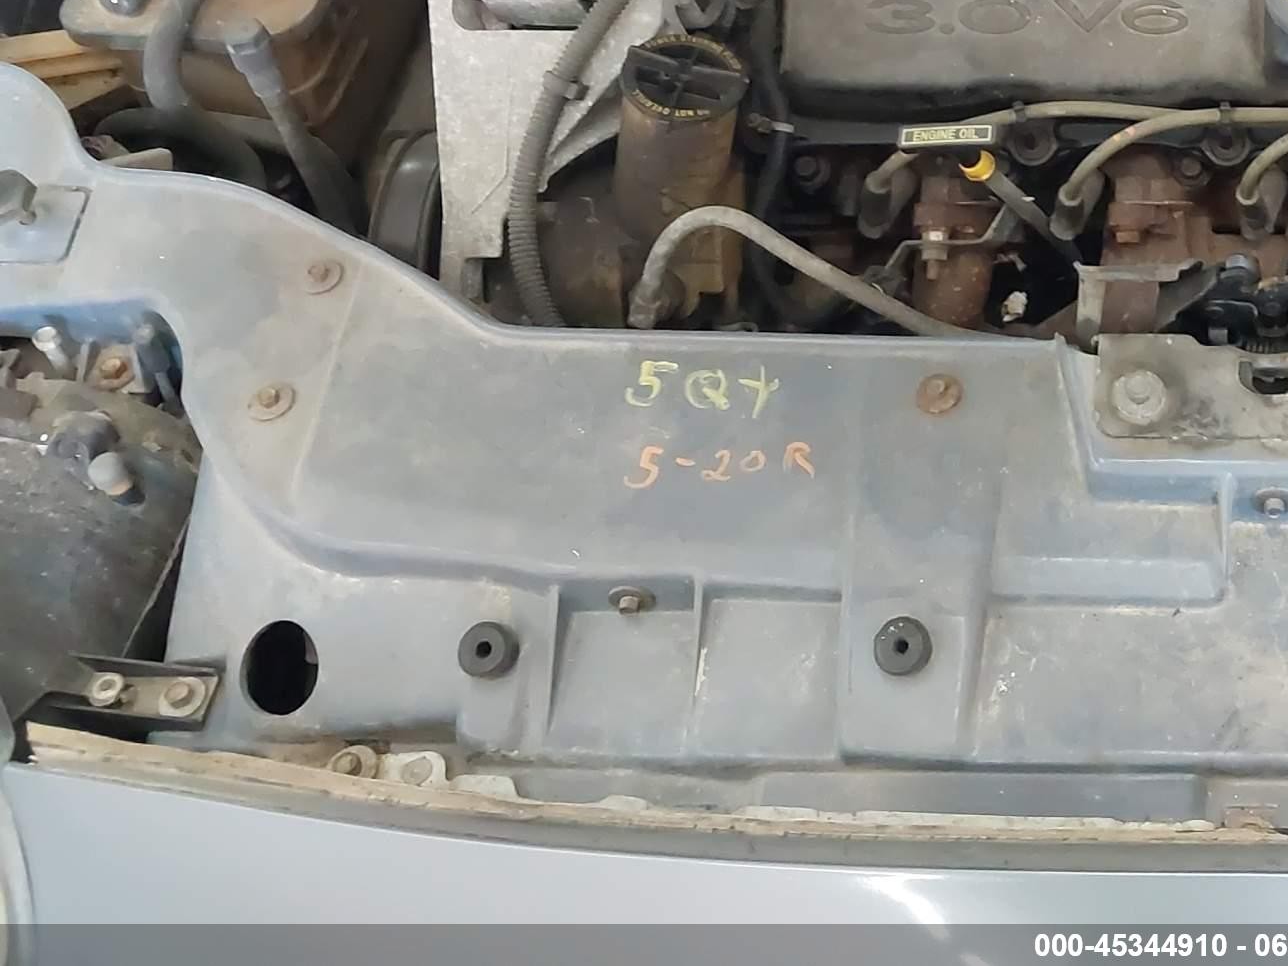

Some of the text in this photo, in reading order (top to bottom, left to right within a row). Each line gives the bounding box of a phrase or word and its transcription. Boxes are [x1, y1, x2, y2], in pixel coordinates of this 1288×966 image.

[912, 127, 979, 142] ENGINE OIL
[624, 360, 679, 407] 5
